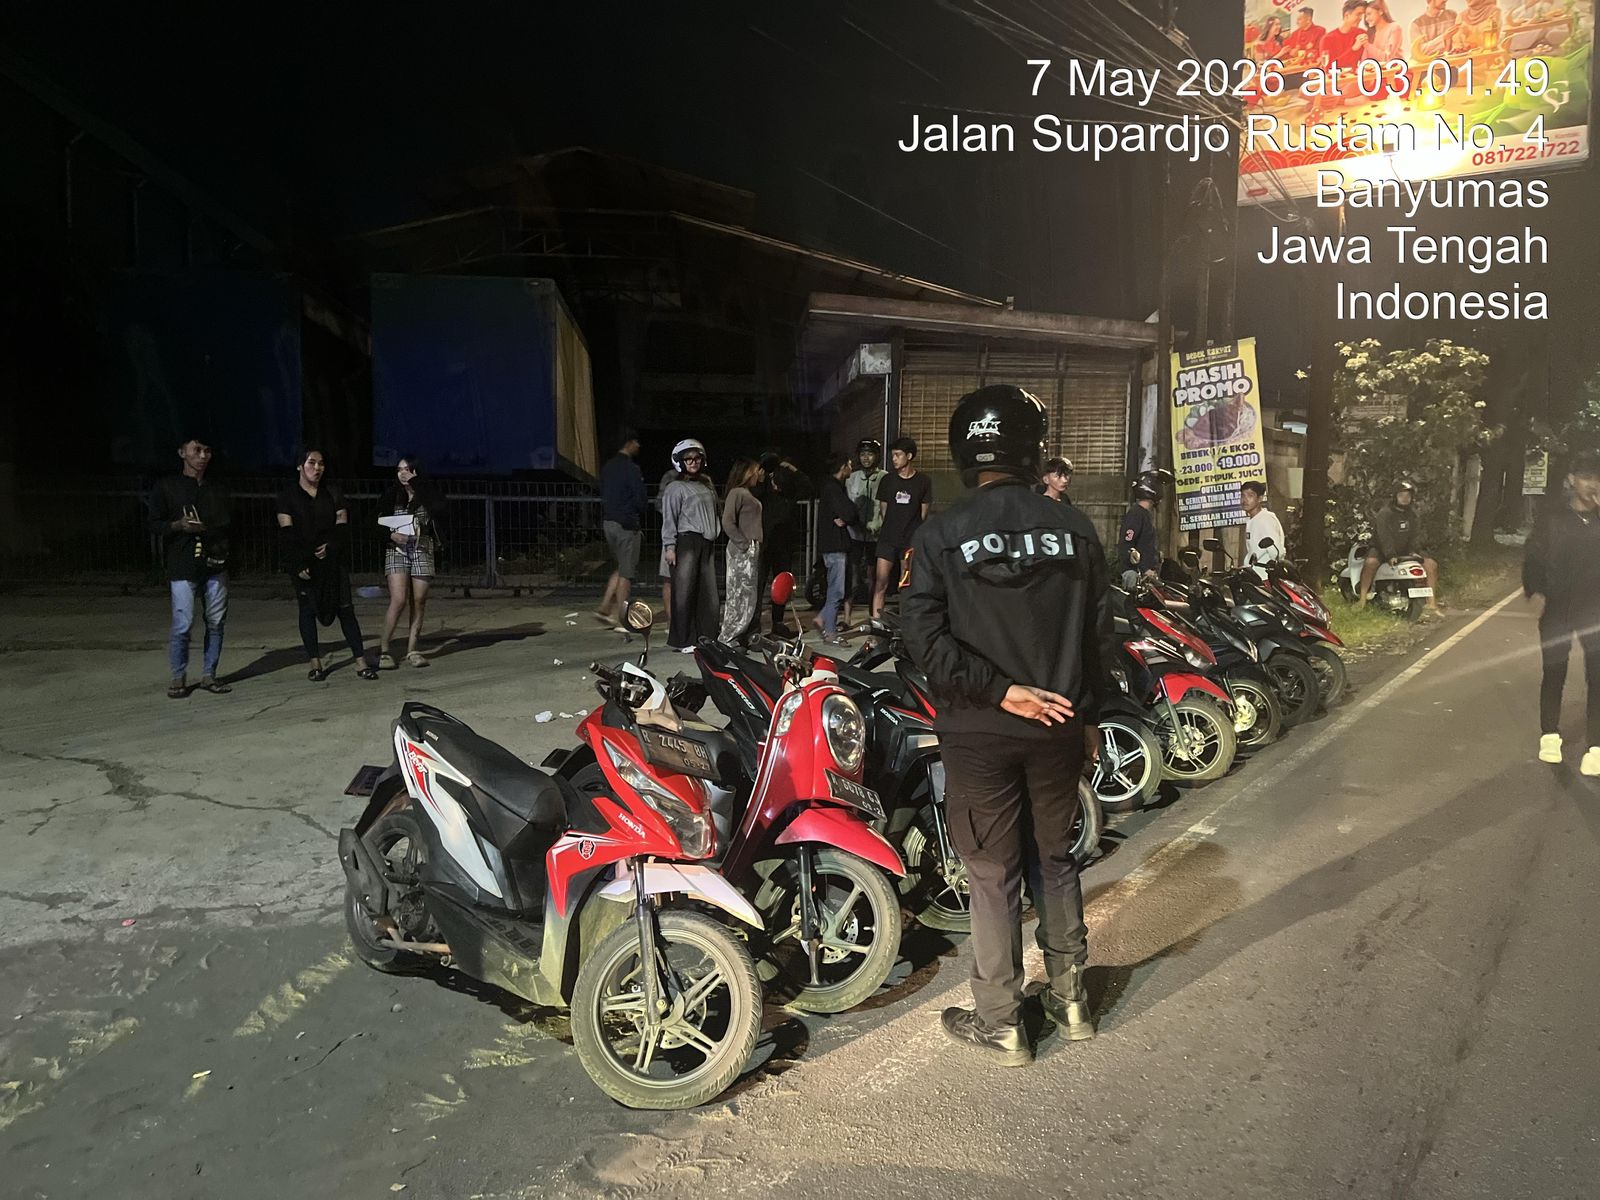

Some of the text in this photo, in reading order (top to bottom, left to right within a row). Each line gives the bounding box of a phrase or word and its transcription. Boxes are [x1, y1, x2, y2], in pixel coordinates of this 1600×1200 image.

[1180, 362, 1242, 388] MASIH
[1175, 378, 1251, 405] PROMO
[1180, 449, 1209, 460] BEBEK
[1230, 443, 1256, 453] EKOR
[1239, 469, 1264, 479] JUICY
[1189, 512, 1221, 523] SEKOLAH
[960, 533, 1074, 563] POLISI
[640, 728, 651, 743] R
[658, 734, 687, 753] 2445
[618, 812, 646, 839] HONDA
